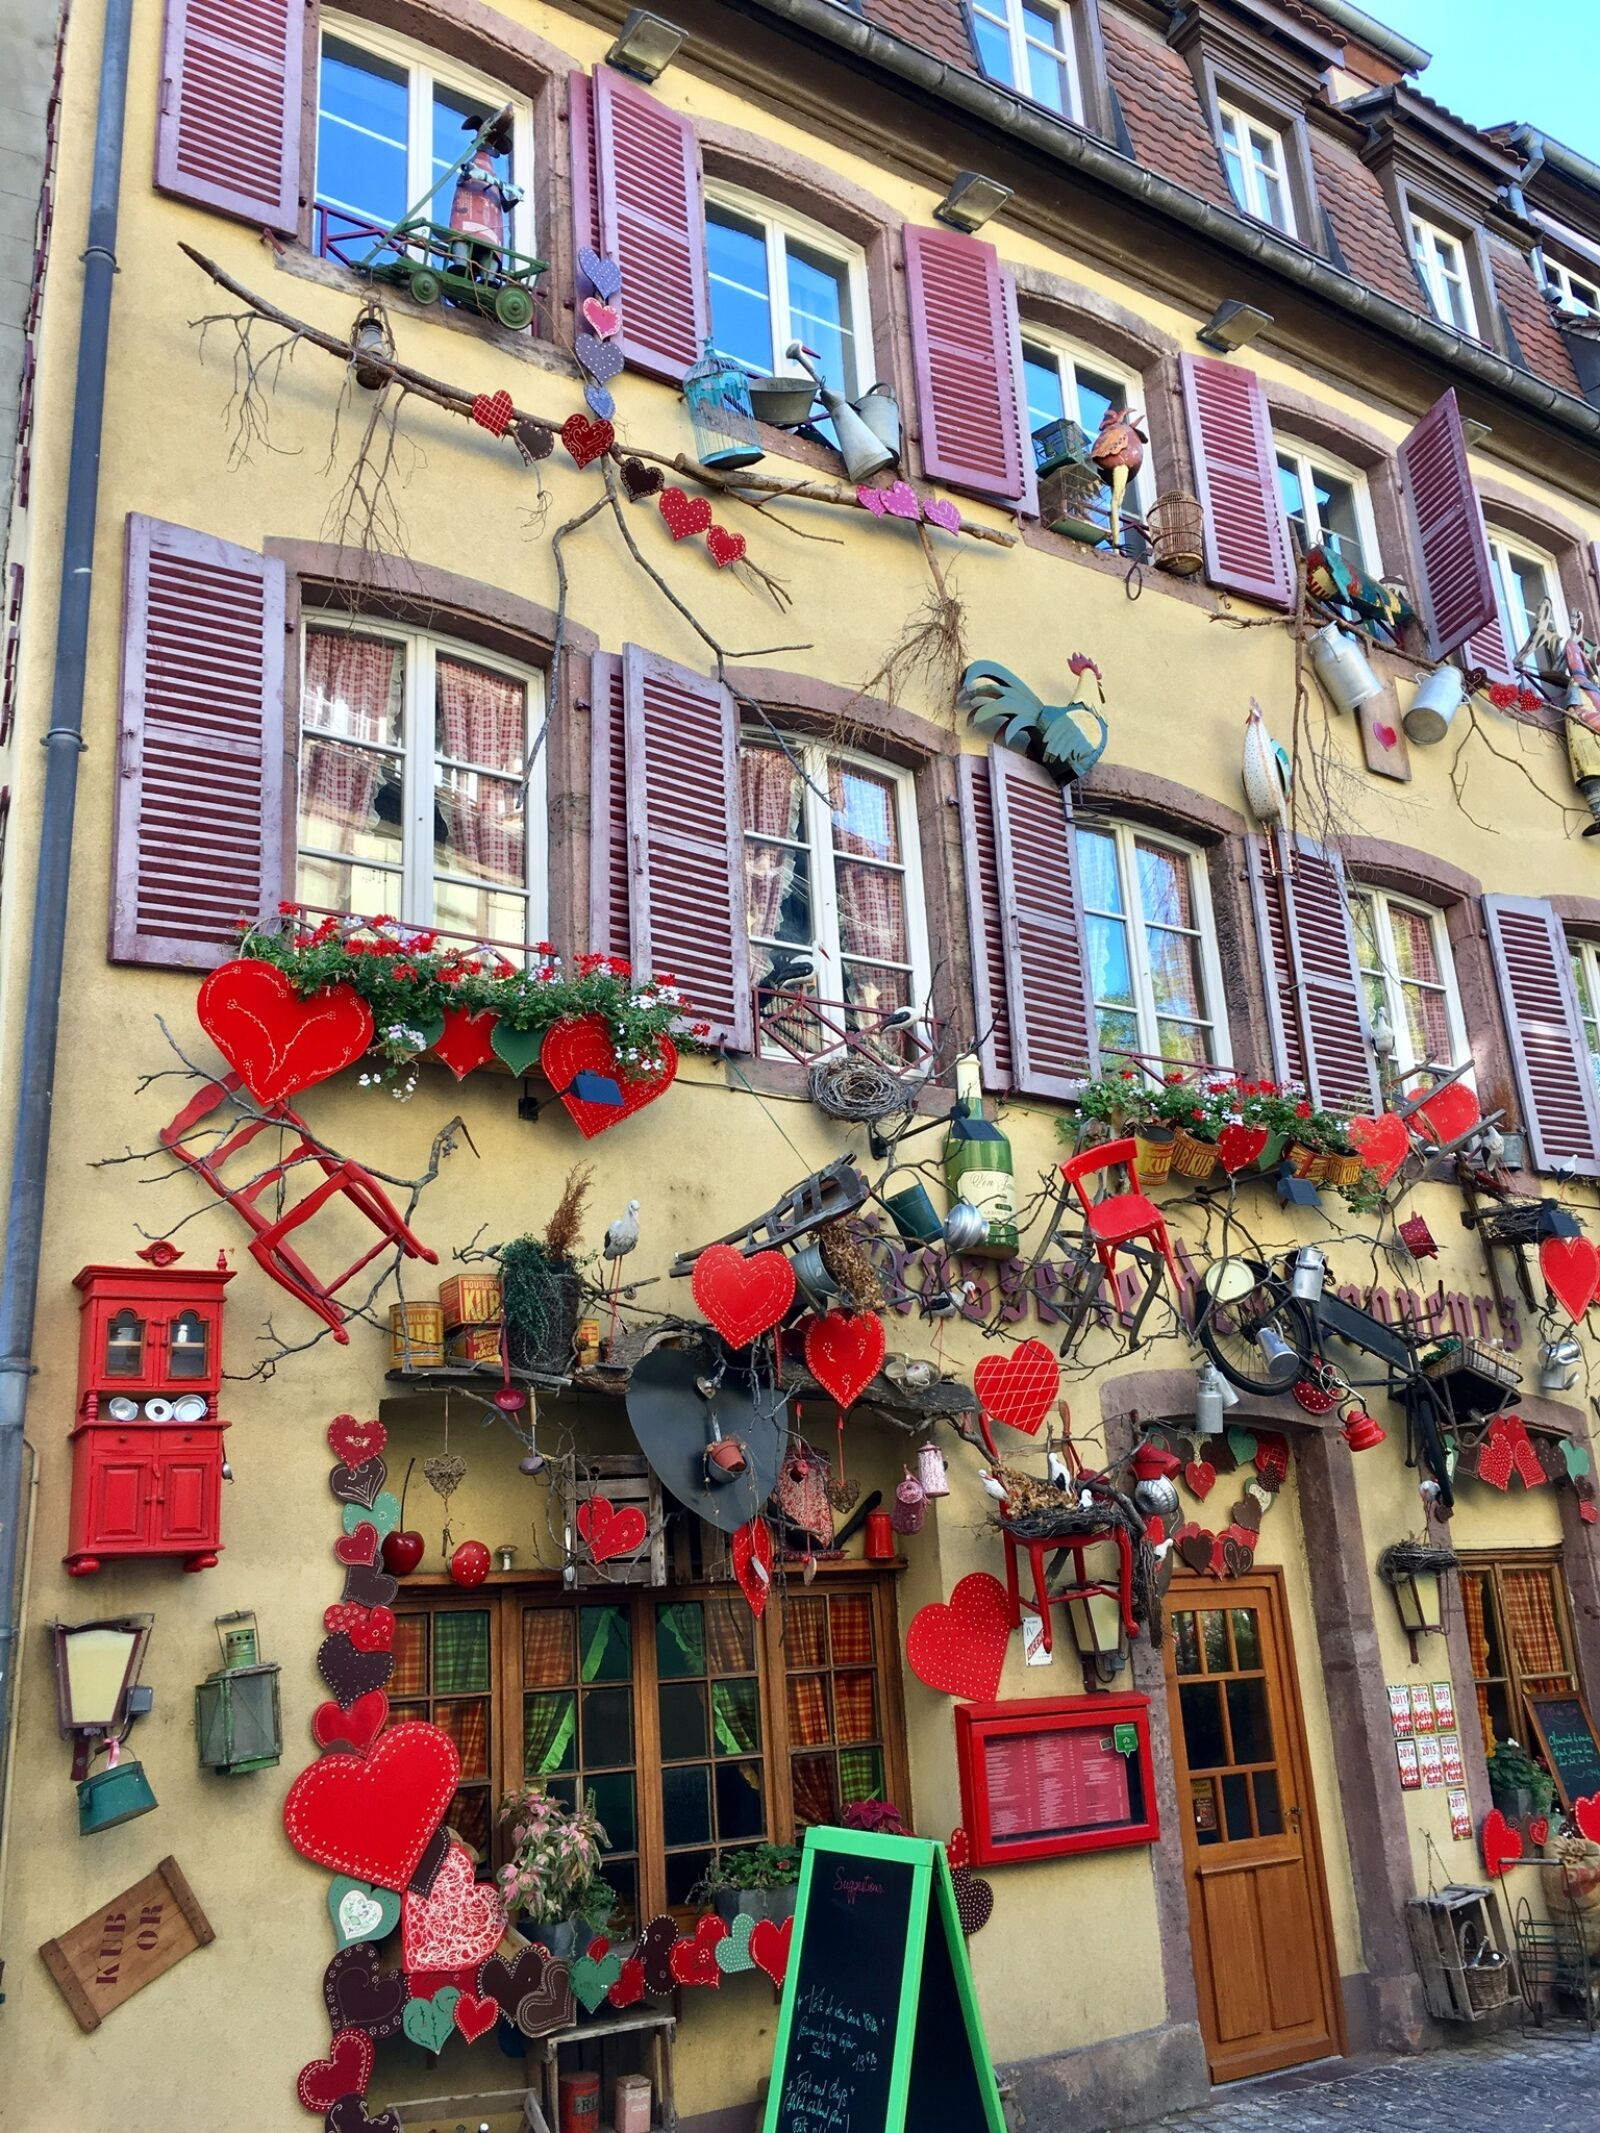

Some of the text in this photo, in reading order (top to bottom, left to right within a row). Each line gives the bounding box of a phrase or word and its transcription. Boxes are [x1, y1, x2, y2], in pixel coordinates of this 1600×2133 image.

[1172, 1143, 1190, 1171] UB
[1186, 1153, 1216, 1177] KUB
[1341, 1166, 1360, 1184] KUB
[463, 1289, 501, 1322] KUB
[473, 1345, 500, 1361] MAGG
[1391, 1694, 1407, 1705] 2011
[1413, 1691, 1428, 1703] 2012
[1435, 1690, 1450, 1701] 2013
[1399, 1747, 1415, 1758] 2014
[1422, 1744, 1437, 1756] 2015
[1443, 1744, 1458, 1755] 2016
[1450, 1796, 1465, 1808] 2017
[136, 1904, 164, 1951] OR
[96, 1913, 127, 1984] KUB
